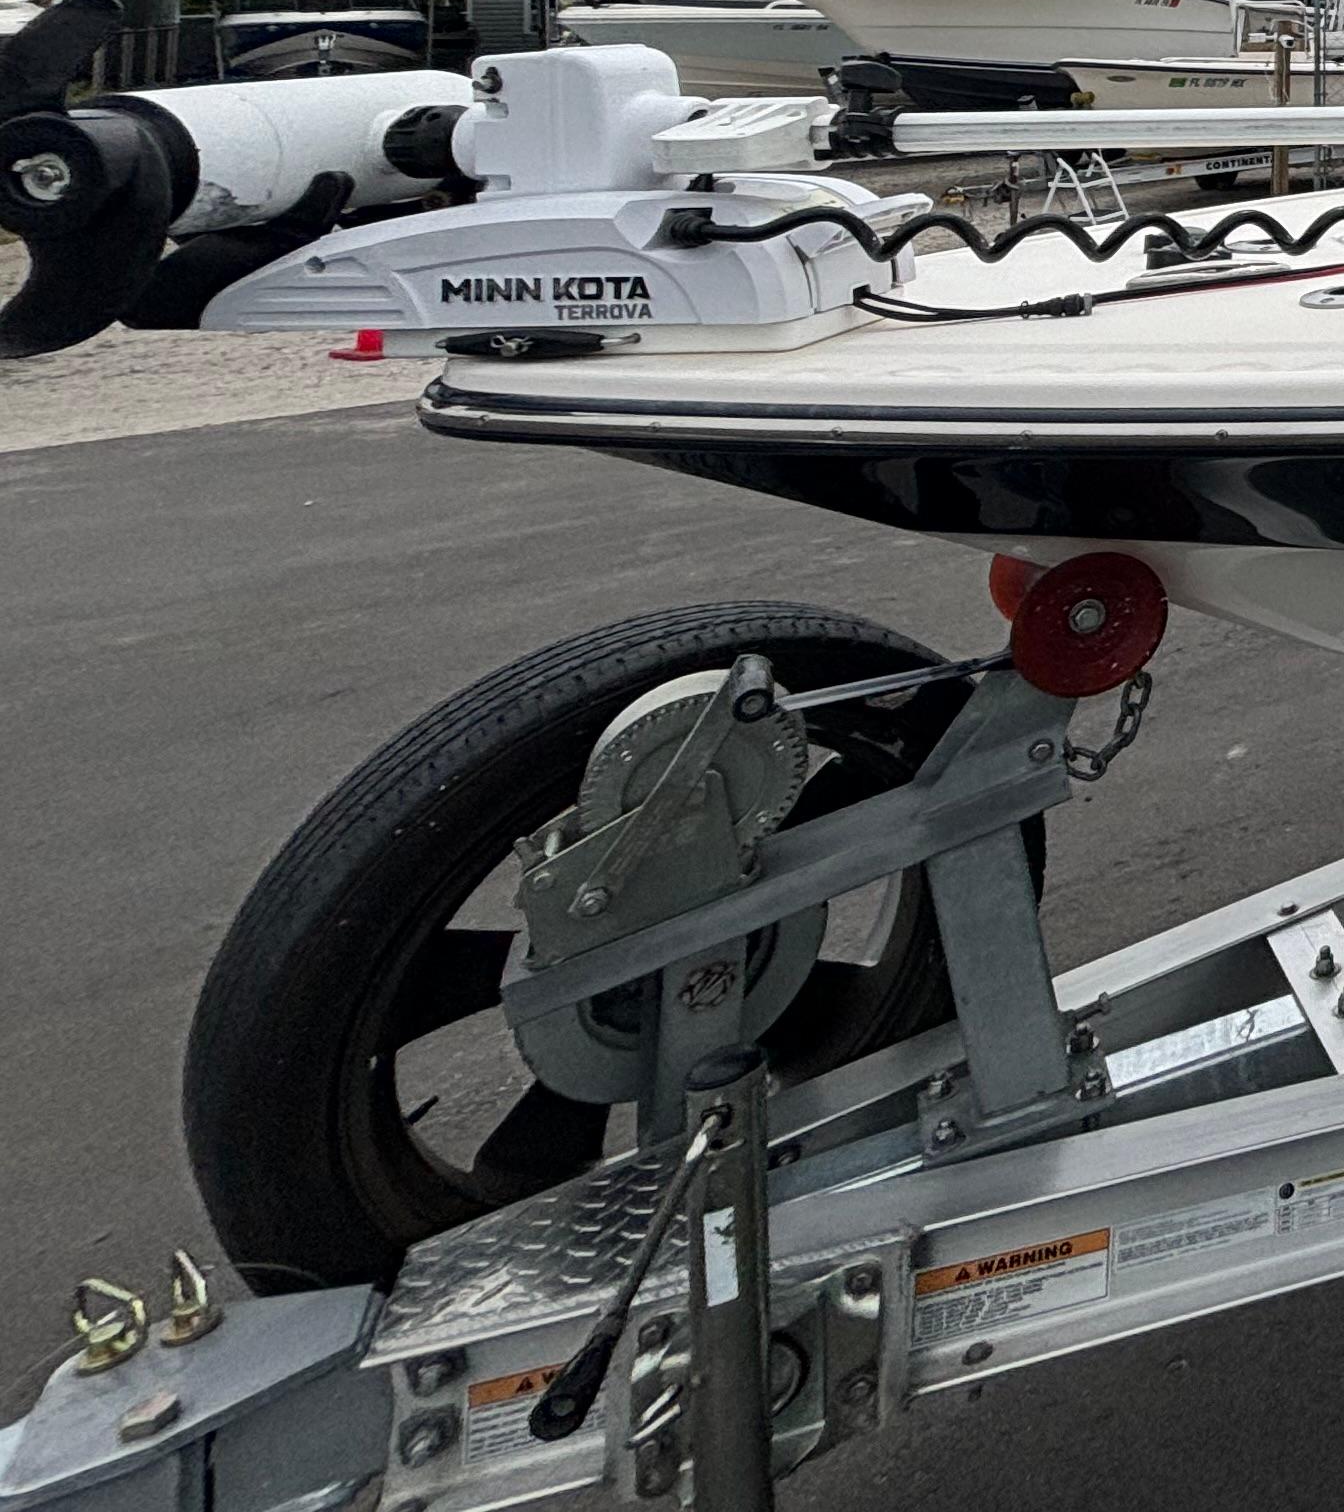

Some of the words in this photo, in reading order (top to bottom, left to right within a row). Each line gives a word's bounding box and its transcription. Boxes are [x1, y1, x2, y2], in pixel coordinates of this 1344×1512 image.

[1205, 154, 1274, 171] CONTINENT
[441, 277, 543, 303] MINN
[552, 276, 652, 300] KOTA
[554, 303, 653, 321] TERROVA
[976, 1241, 1073, 1275] WARNING
